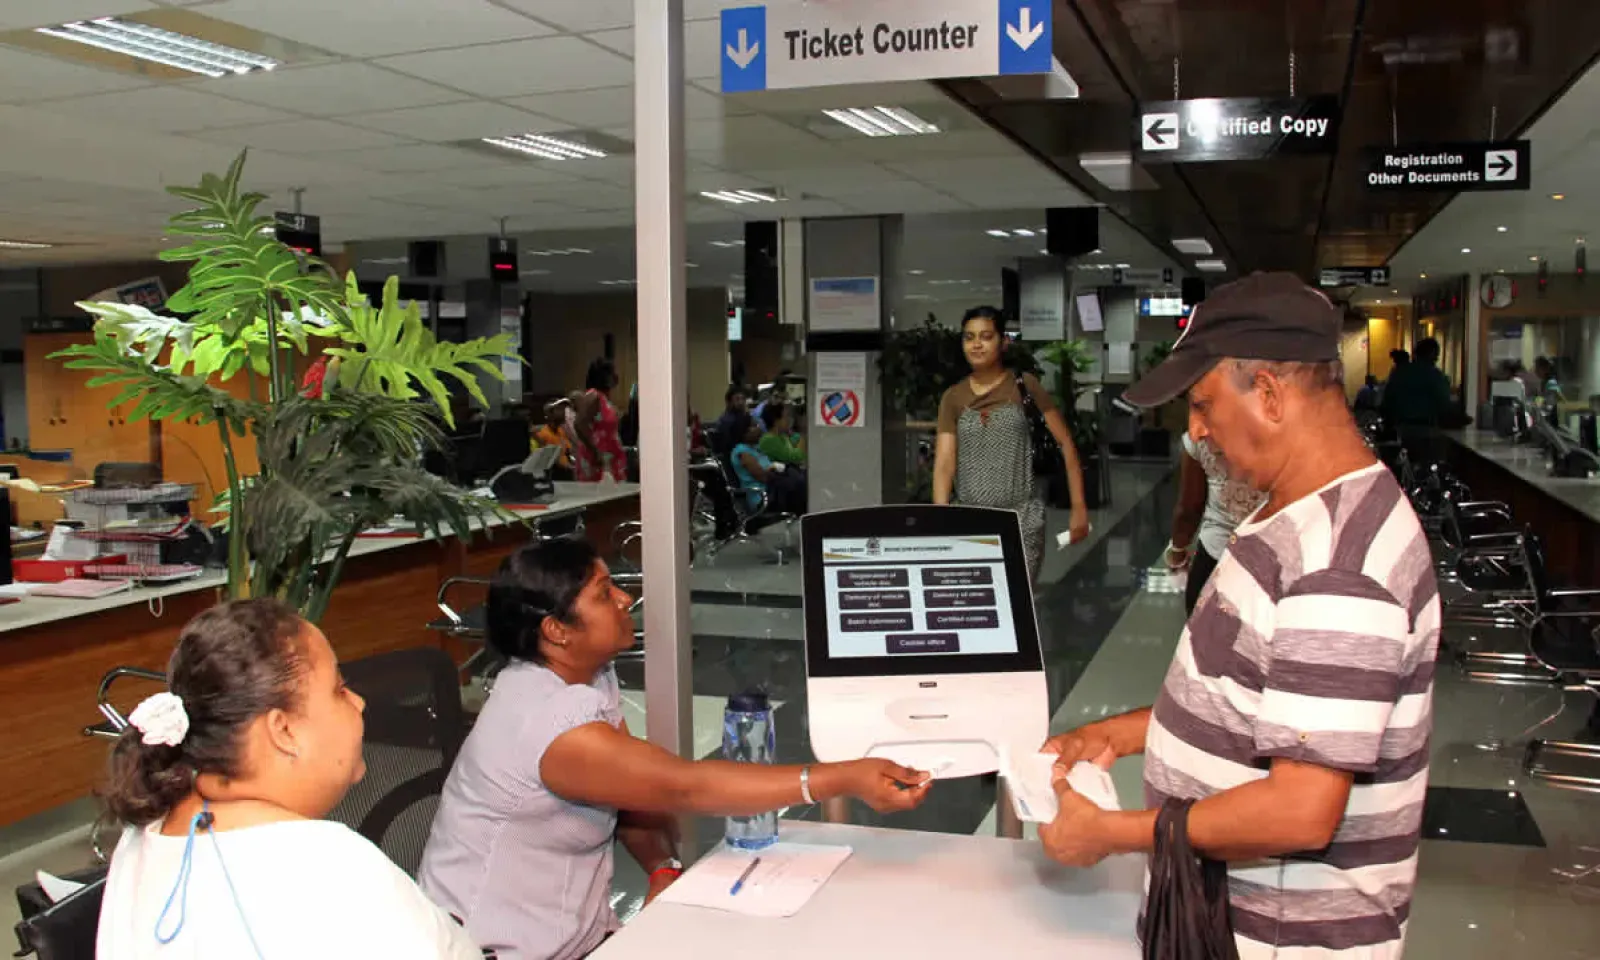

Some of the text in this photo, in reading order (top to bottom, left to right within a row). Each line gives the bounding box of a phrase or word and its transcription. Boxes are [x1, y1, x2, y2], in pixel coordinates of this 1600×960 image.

[784, 20, 979, 61] Ticket Counter
[1279, 115, 1329, 138] Copy
[1385, 151, 1463, 169] Registration
[1368, 170, 1480, 185] Other Documents
